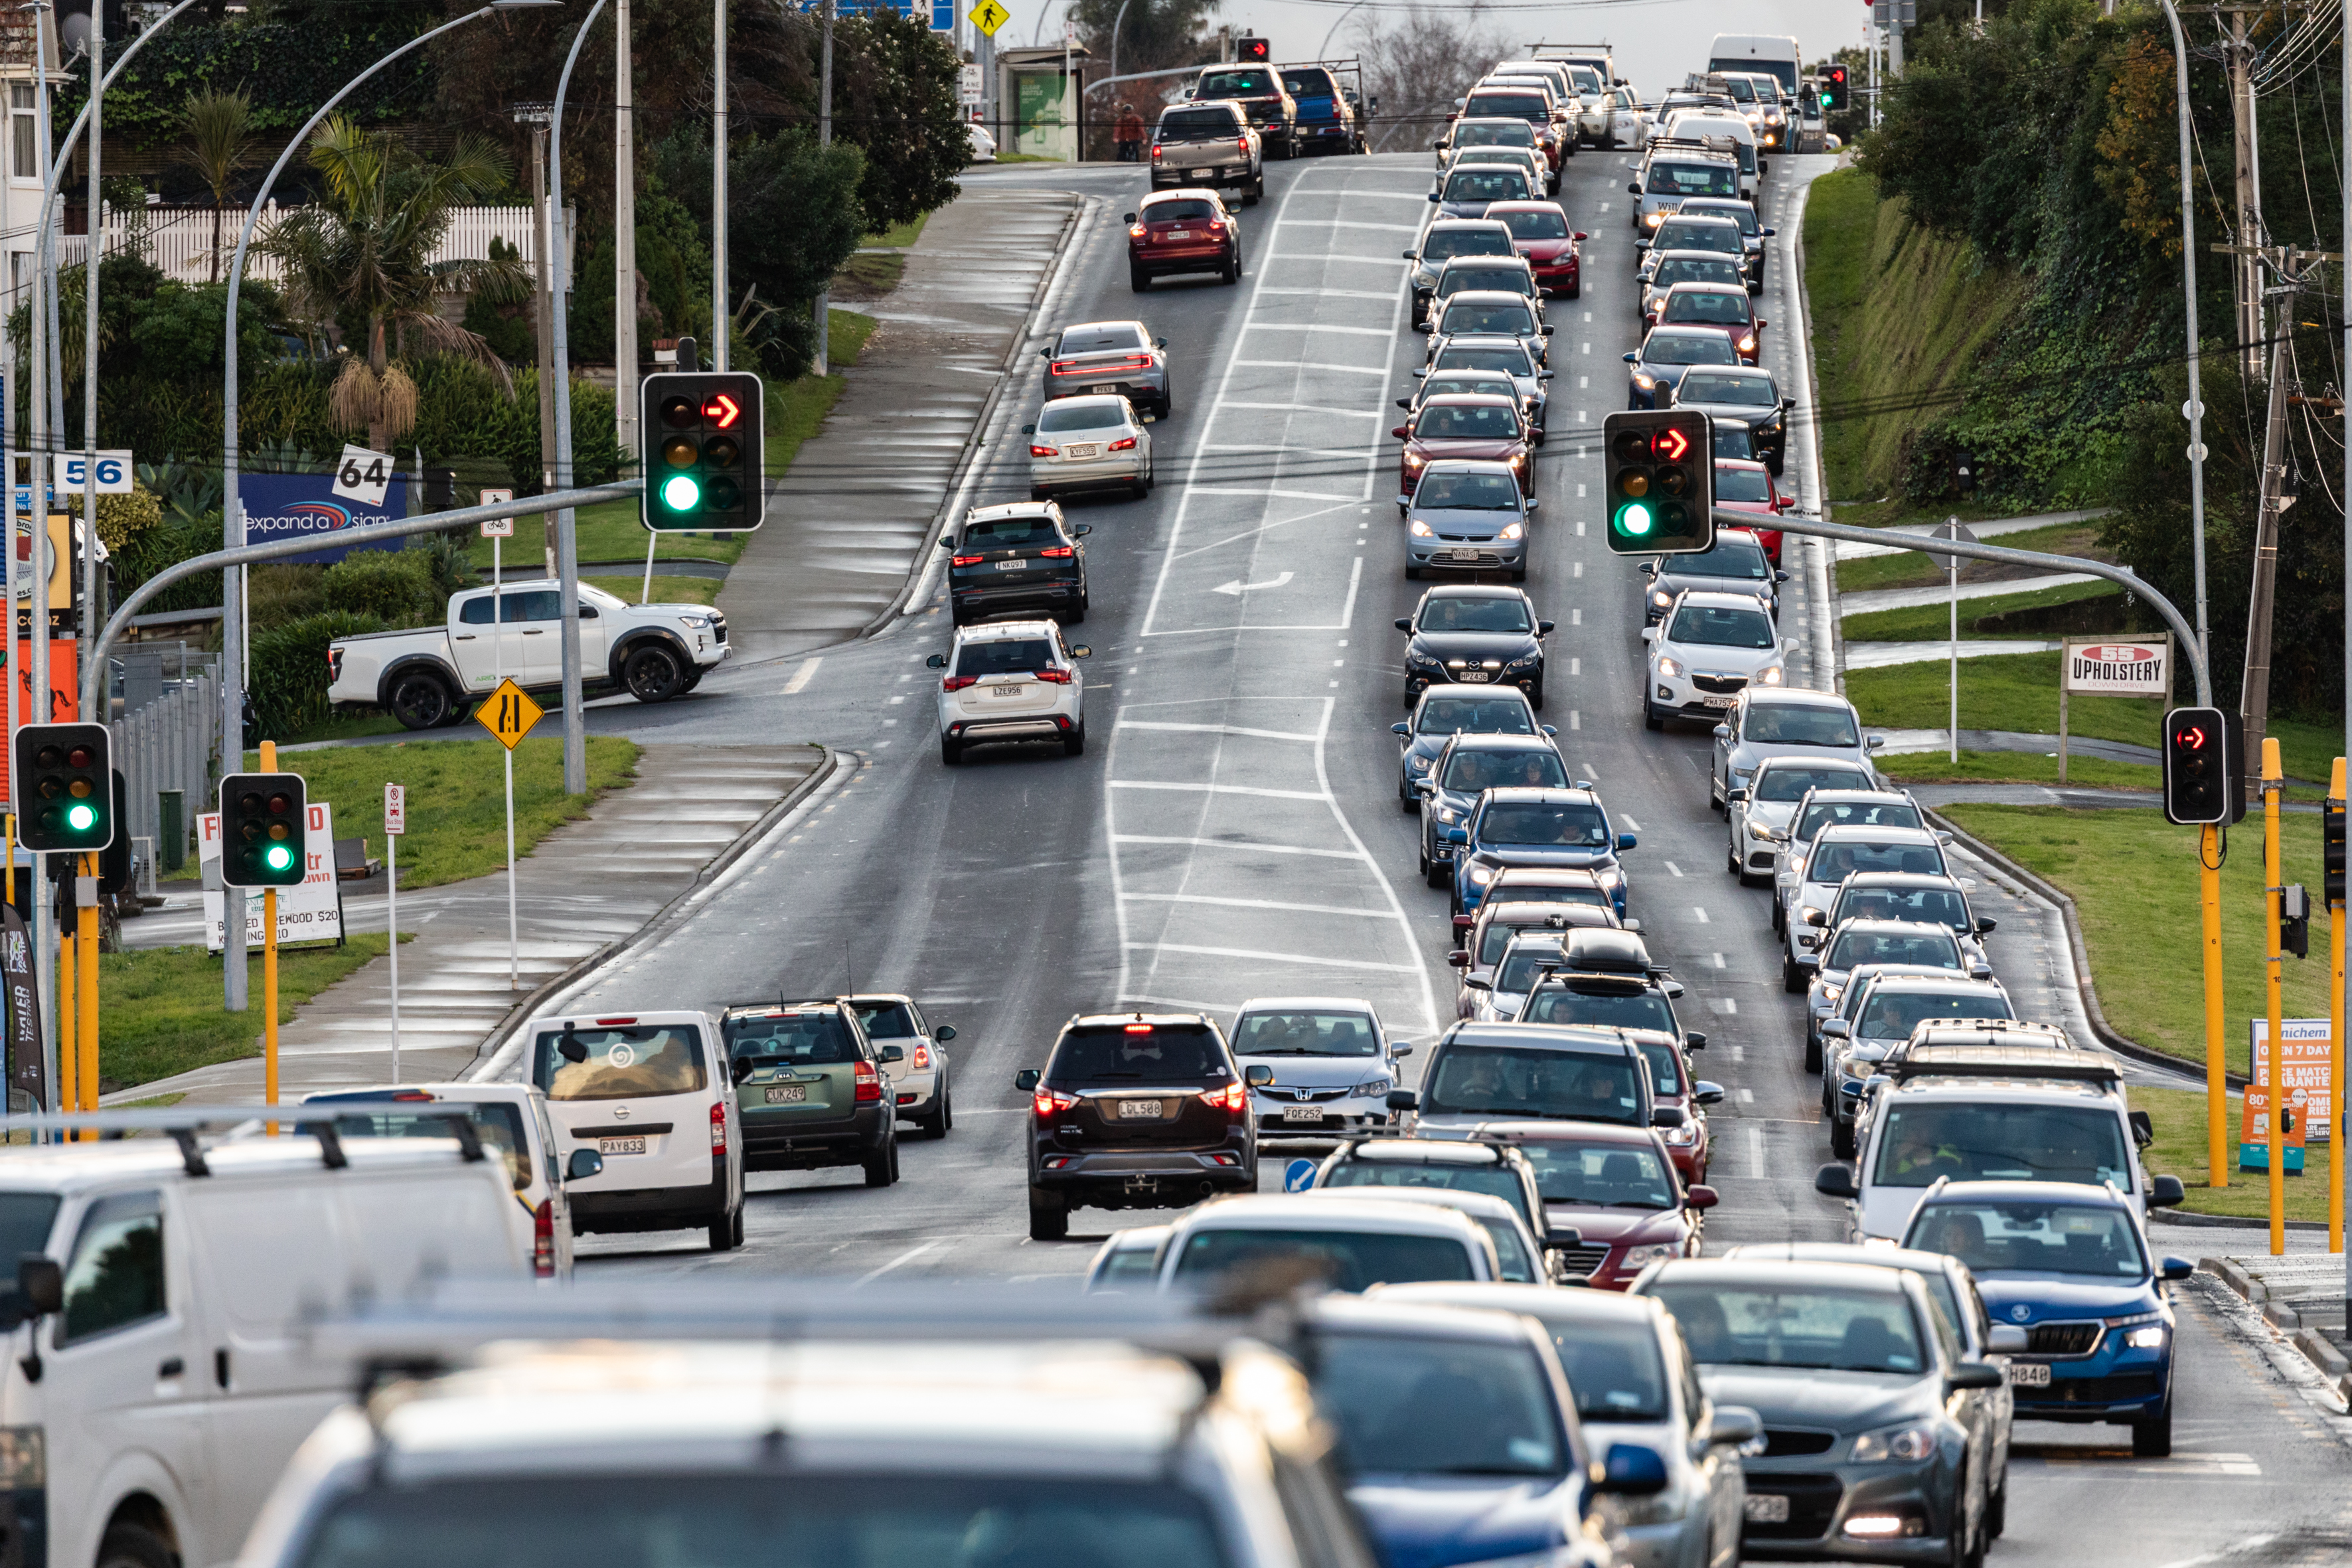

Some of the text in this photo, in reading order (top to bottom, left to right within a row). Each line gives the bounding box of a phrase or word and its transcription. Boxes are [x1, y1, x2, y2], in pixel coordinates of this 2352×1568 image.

[1658, 202, 1681, 211] Will
[1071, 447, 1095, 456] KYF559
[66, 460, 122, 485] 56
[340, 459, 386, 488] 64
[246, 512, 313, 533] expand
[317, 516, 329, 530] a
[2101, 647, 2135, 661] 55
[2074, 657, 2161, 681] UPHOLSTERY
[994, 686, 1021, 696] LZE956
[307, 852, 321, 870] tr
[245, 896, 288, 907] ANDSPE
[318, 910, 338, 922] $20
[2281, 1027, 2327, 1038] nichem
[2296, 1045, 2304, 1056] 7
[2306, 1045, 2331, 1056] DAY
[2296, 1067, 2331, 1077] MATC
[2260, 1076, 2331, 1087] GRANTE
[767, 1088, 803, 1100] CUK249
[2308, 1097, 2331, 1107] OME
[1286, 1109, 1320, 1119] FQE252
[2307, 1106, 2331, 1116] RIES
[603, 1140, 643, 1152] PAY833
